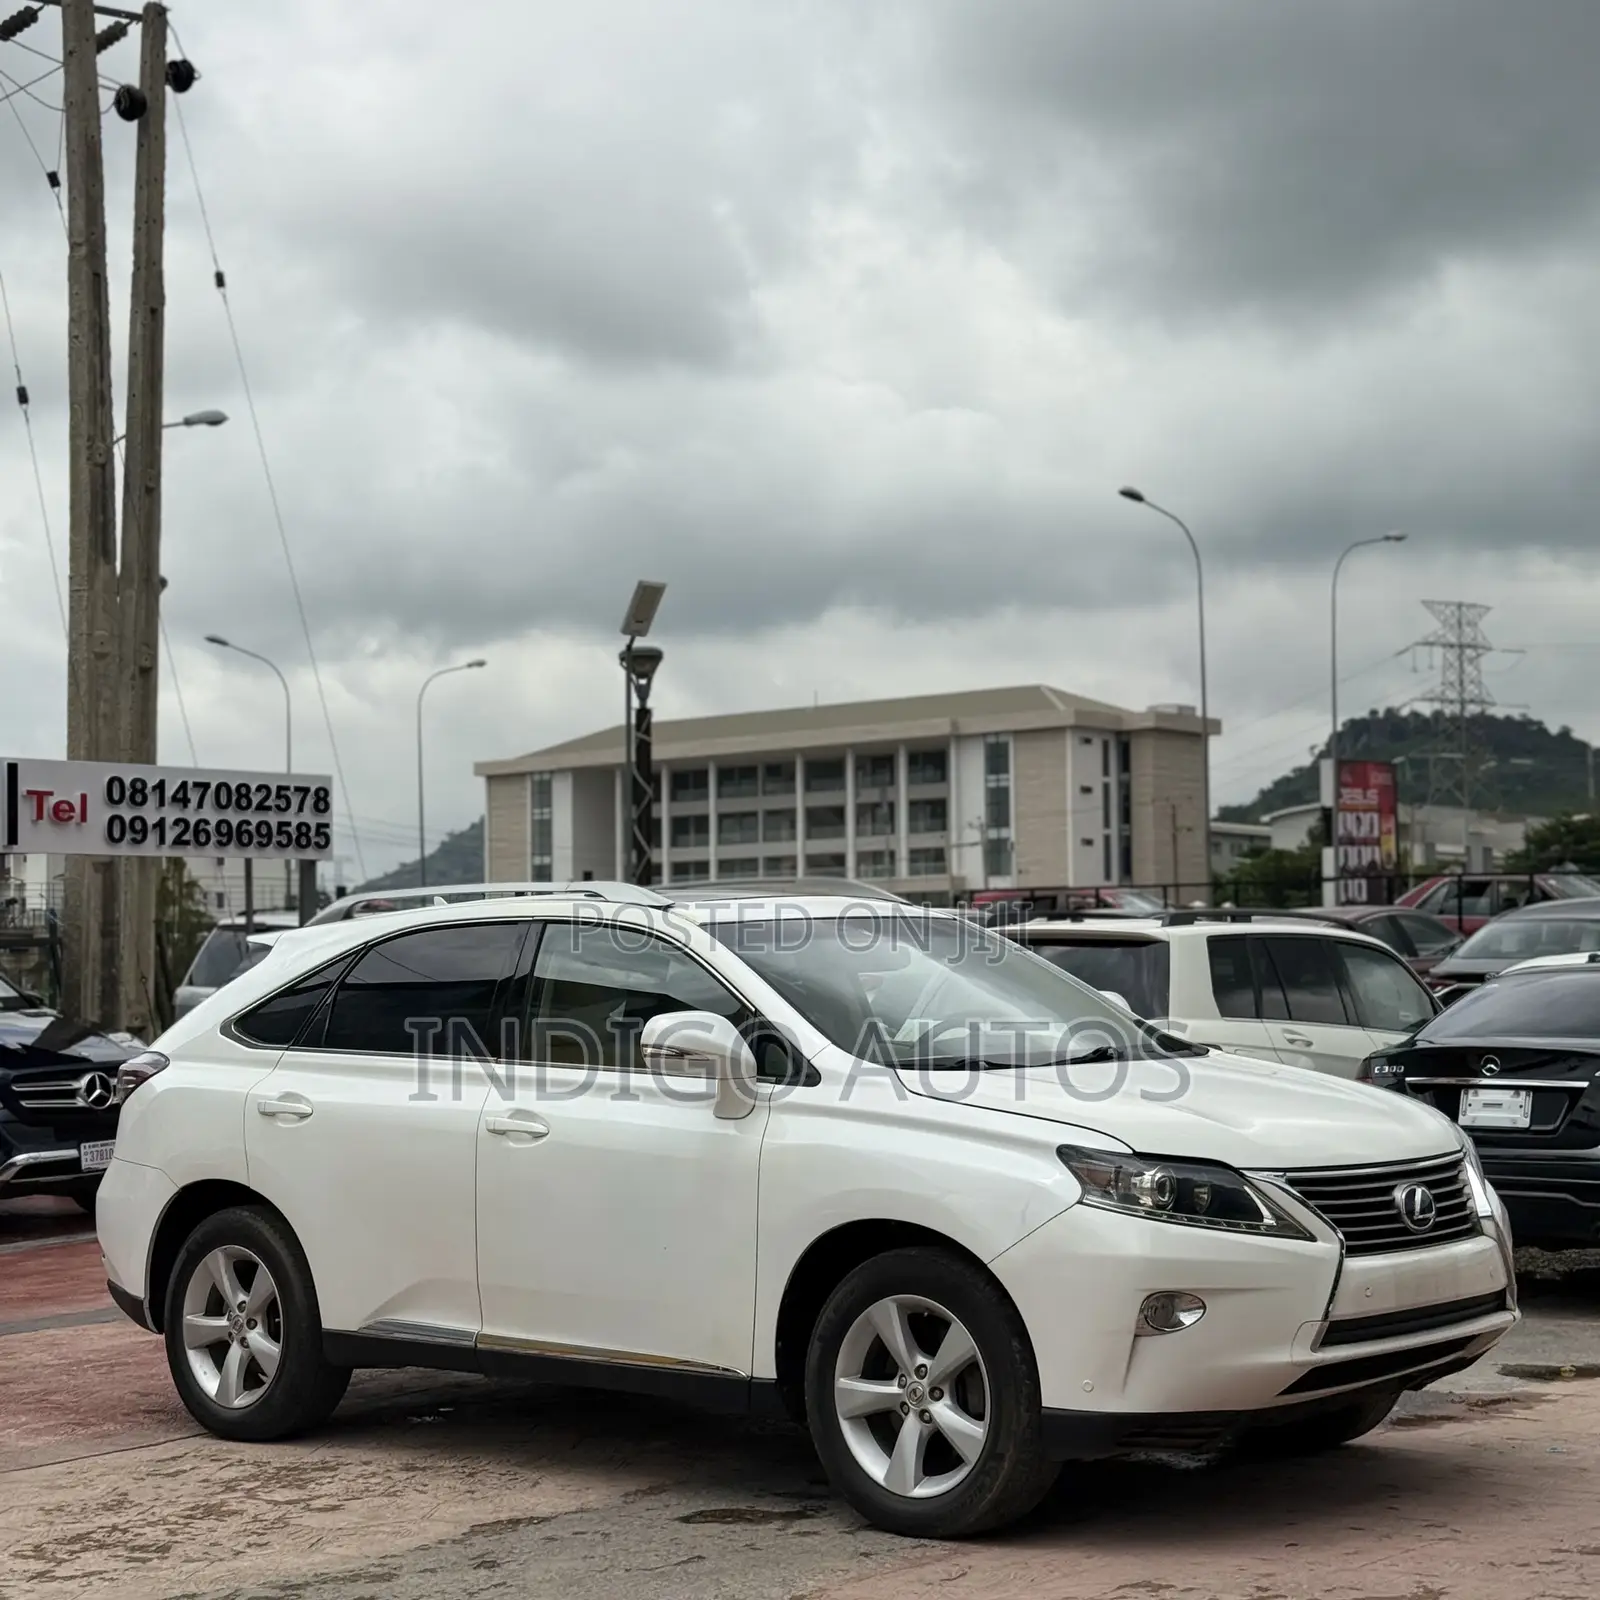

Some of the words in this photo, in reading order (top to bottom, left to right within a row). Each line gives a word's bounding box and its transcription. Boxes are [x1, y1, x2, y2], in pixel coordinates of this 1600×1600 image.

[26, 789, 88, 823] Tel
[105, 775, 330, 814] 08147082578
[106, 814, 330, 850] 09126969585
